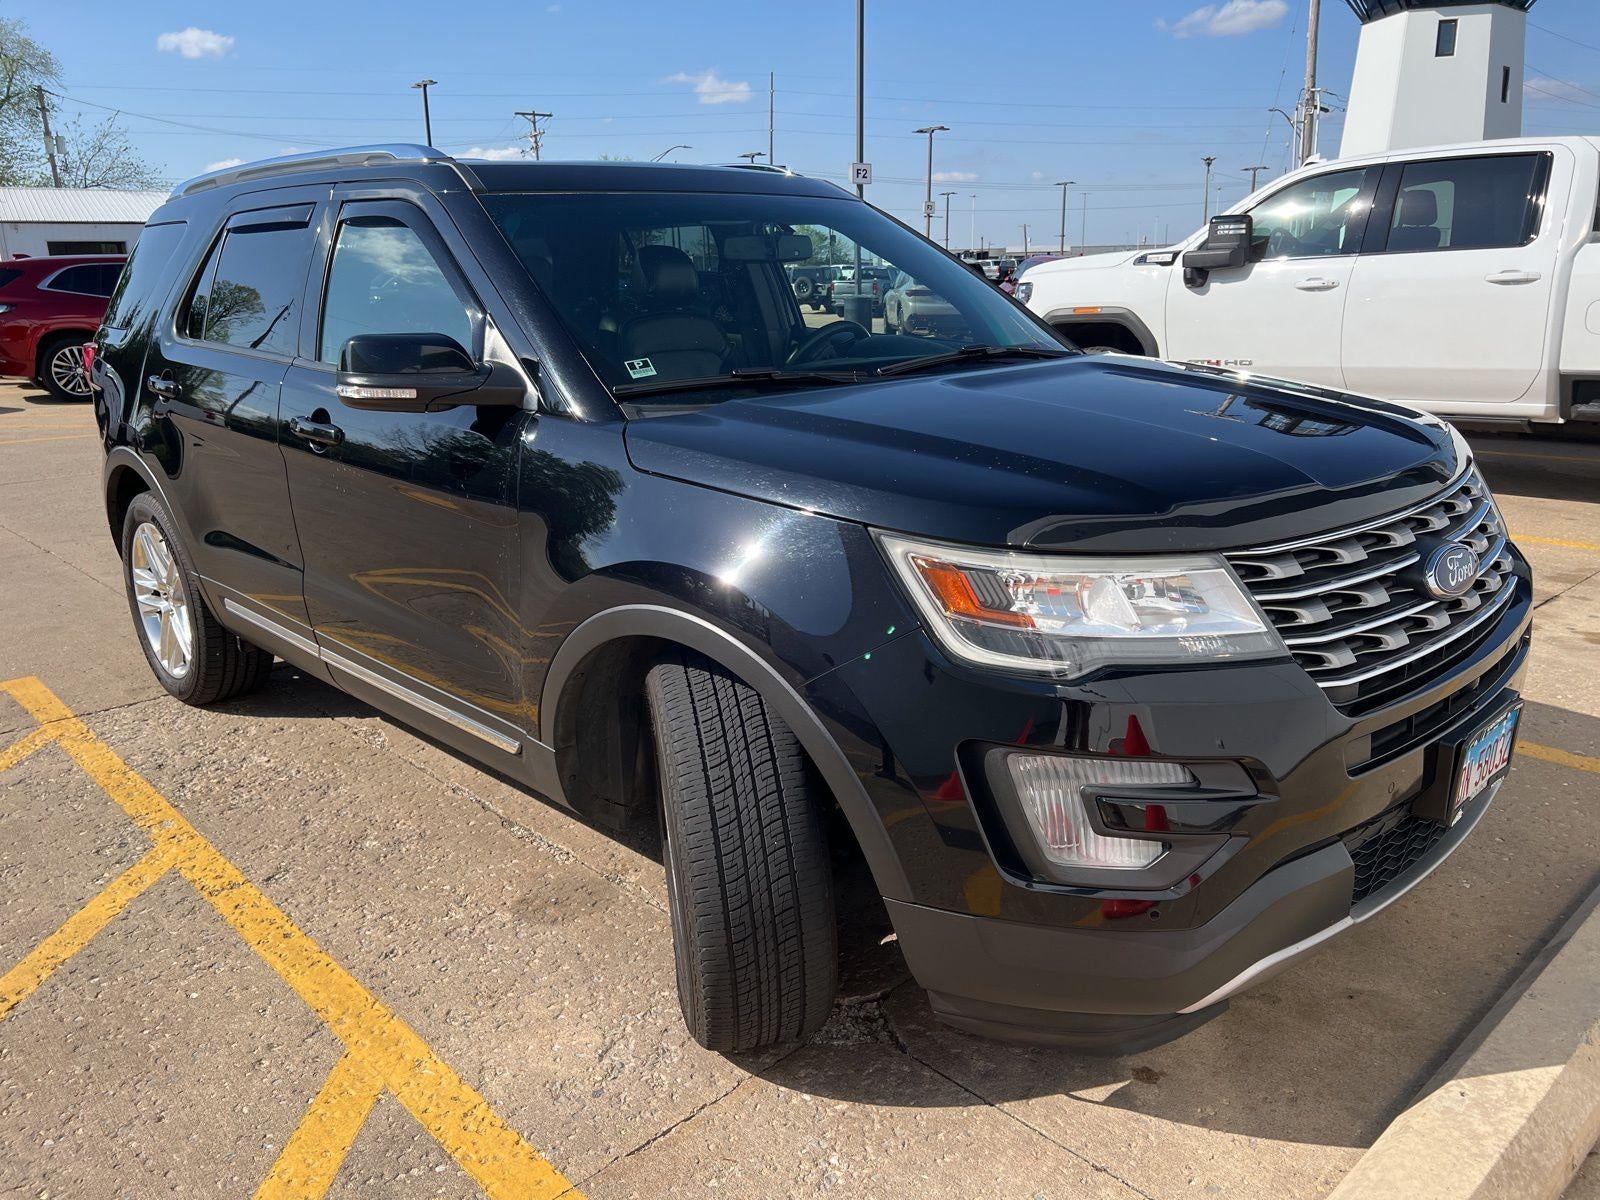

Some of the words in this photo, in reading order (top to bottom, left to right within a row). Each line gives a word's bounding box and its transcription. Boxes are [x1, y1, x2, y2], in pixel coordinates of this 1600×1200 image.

[856, 168, 868, 179] F2
[633, 361, 643, 370] P
[1446, 552, 1474, 587] Ford
